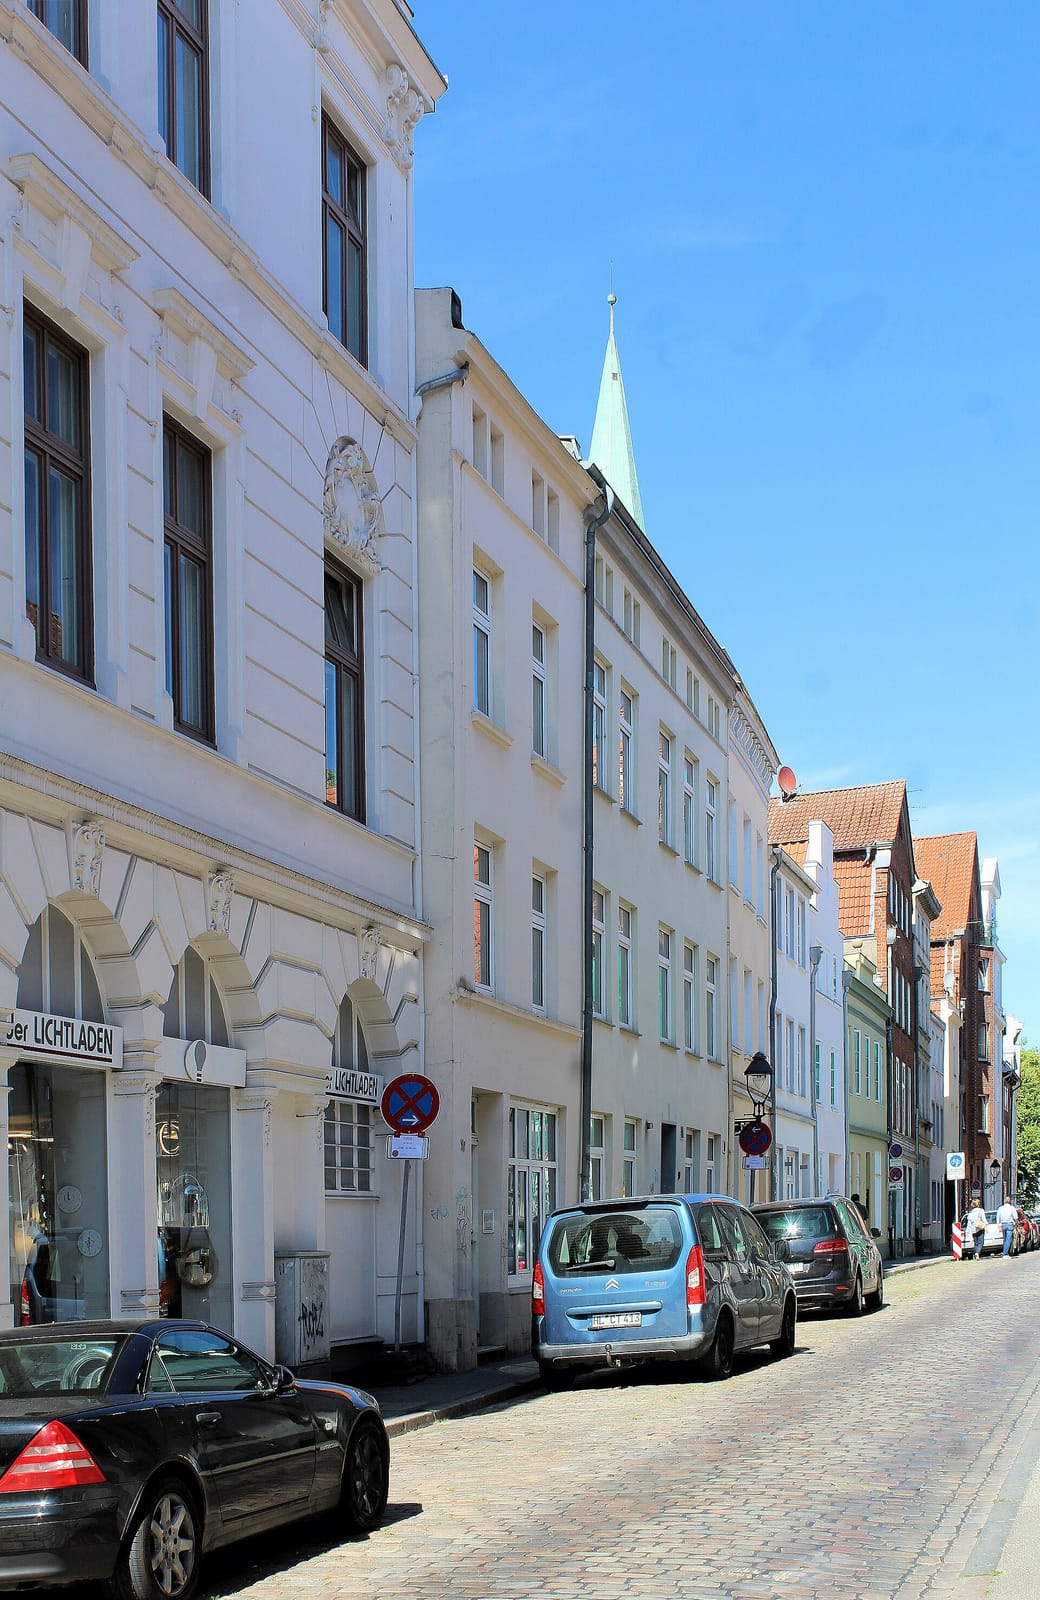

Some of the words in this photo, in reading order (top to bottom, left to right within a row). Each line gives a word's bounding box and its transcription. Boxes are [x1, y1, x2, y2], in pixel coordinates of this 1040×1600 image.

[34, 1015, 113, 1055] LICHTLADEN
[335, 1070, 378, 1097] LICHTLADEN
[593, 1316, 605, 1326] HL
[609, 1314, 622, 1325] CT
[624, 1312, 640, 1324] 413
